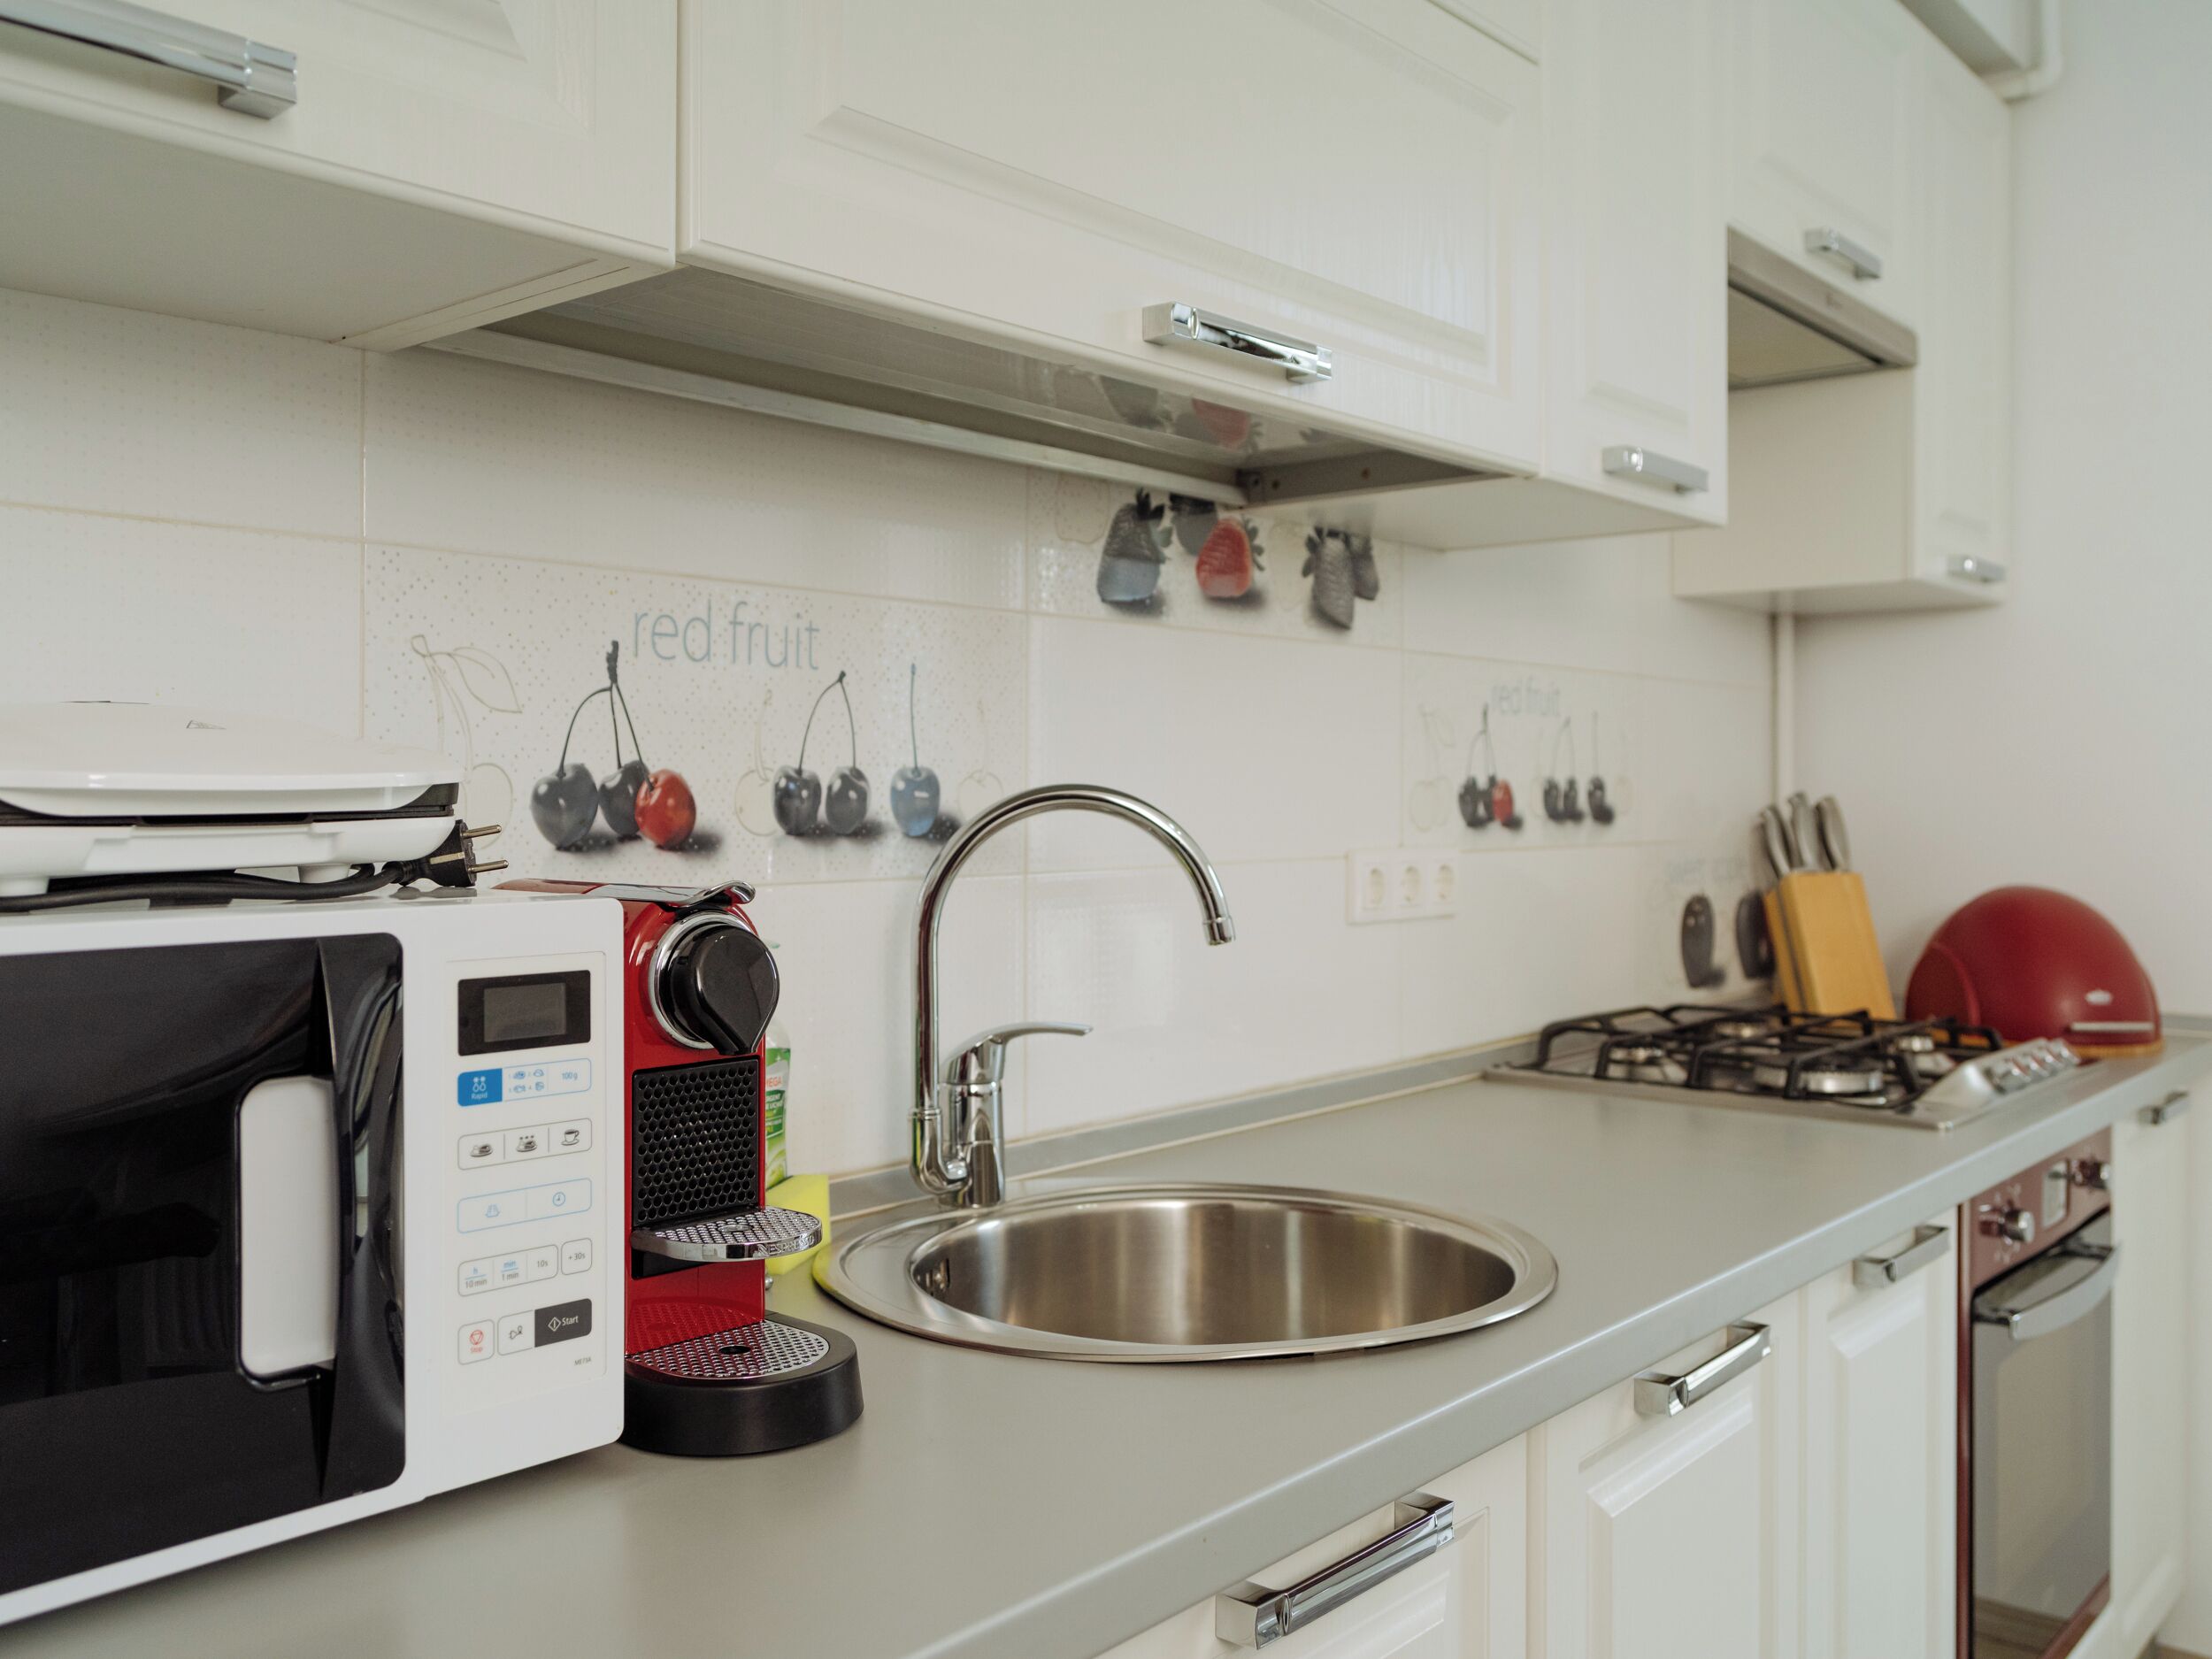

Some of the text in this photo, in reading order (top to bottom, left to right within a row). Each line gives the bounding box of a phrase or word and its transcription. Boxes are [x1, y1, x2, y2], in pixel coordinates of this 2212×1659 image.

[634, 598, 820, 670] red fruit
[562, 1315, 580, 1326] Start
